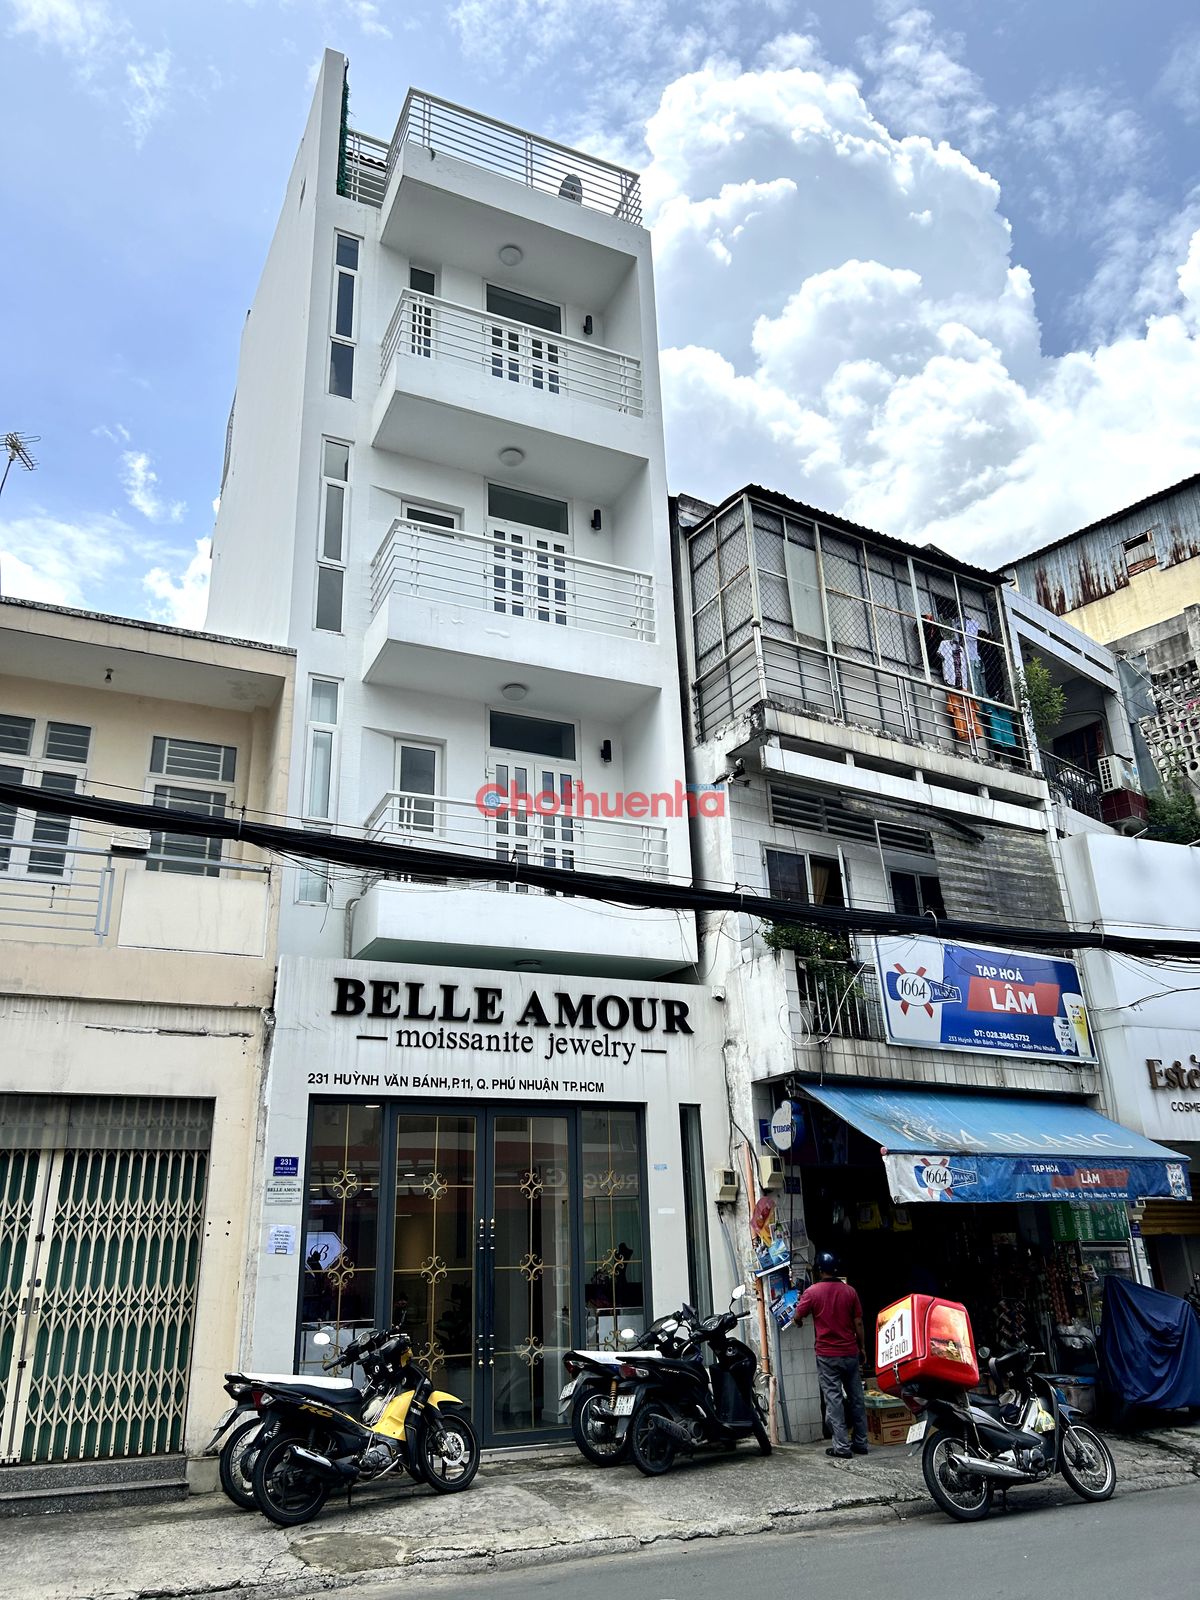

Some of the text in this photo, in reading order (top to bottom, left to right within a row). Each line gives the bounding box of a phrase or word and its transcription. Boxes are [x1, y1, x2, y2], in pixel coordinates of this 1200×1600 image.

[975, 964, 997, 980] TẠP
[900, 977, 928, 999] 1664
[988, 983, 1039, 1015] LÂM
[331, 976, 695, 1034] BELLE AMOUR
[395, 1026, 636, 1065] moissanite jewelry
[307, 1072, 330, 1085] 231
[334, 1070, 379, 1086] HUỲNH
[384, 1073, 409, 1087] VĂN
[476, 1078, 489, 1090] Q.
[491, 1076, 516, 1090] PHÚ
[518, 1077, 559, 1093] NHUẬN
[562, 1080, 605, 1093] TP.HCM
[280, 1158, 292, 1166] 231
[925, 1168, 949, 1185] 1664
[884, 1312, 905, 1345] SỐ 1
